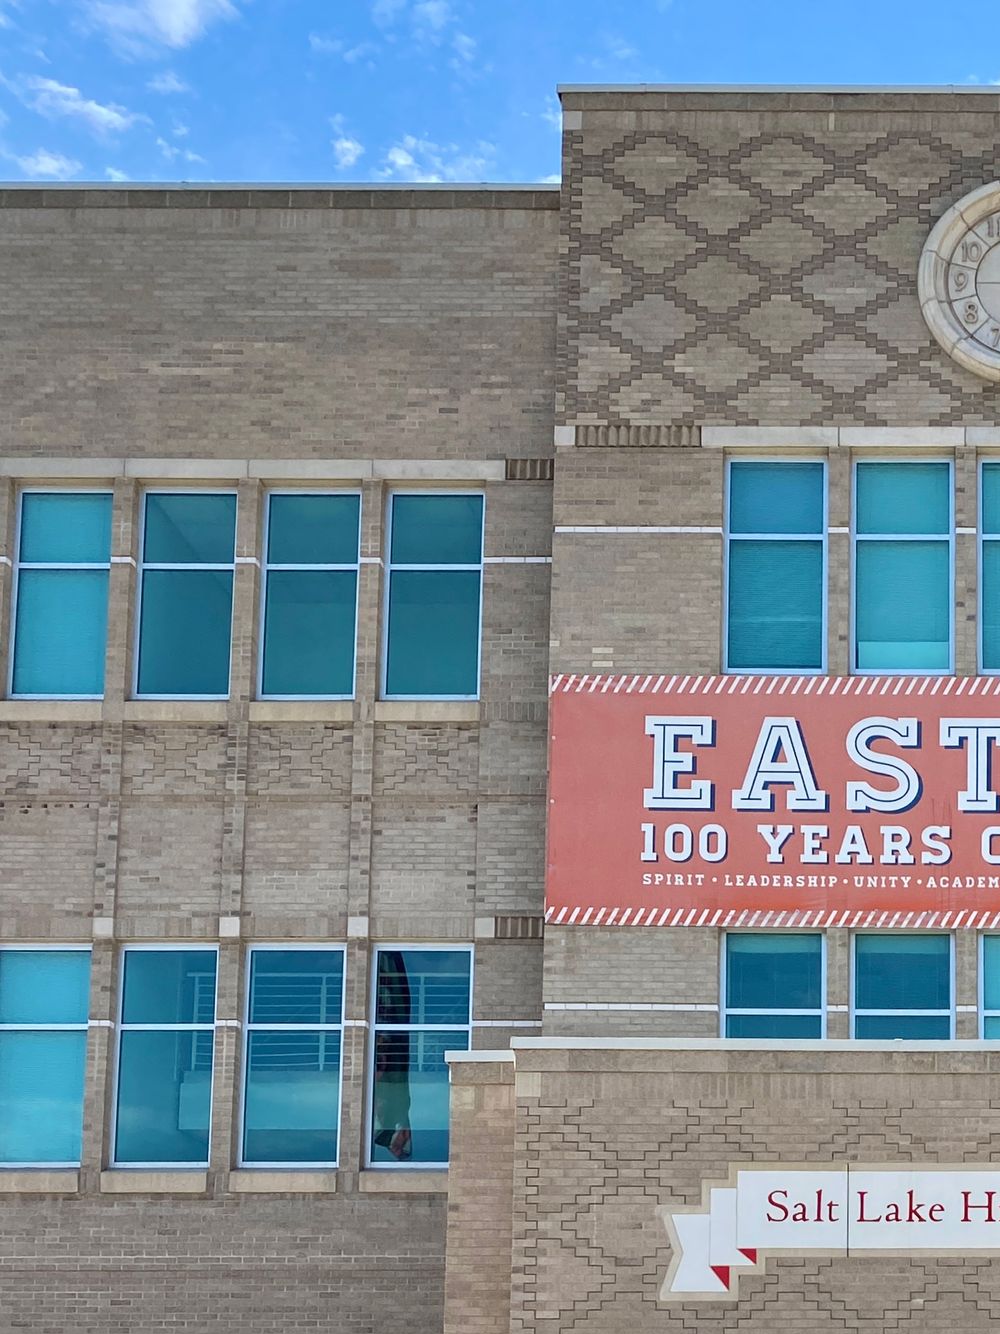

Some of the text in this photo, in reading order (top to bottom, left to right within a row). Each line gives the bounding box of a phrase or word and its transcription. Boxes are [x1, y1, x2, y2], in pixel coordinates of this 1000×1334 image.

[962, 241, 982, 262] 10
[954, 272, 968, 292] 9
[964, 302, 978, 324] 8
[640, 823, 728, 863] 100
[757, 824, 952, 866] YEARS
[642, 873, 705, 887] SPIRIT
[724, 874, 838, 888] LEADERSHIP
[853, 875, 912, 889] UNITY
[766, 1189, 839, 1223] Salt
[856, 1189, 945, 1223] Lake
